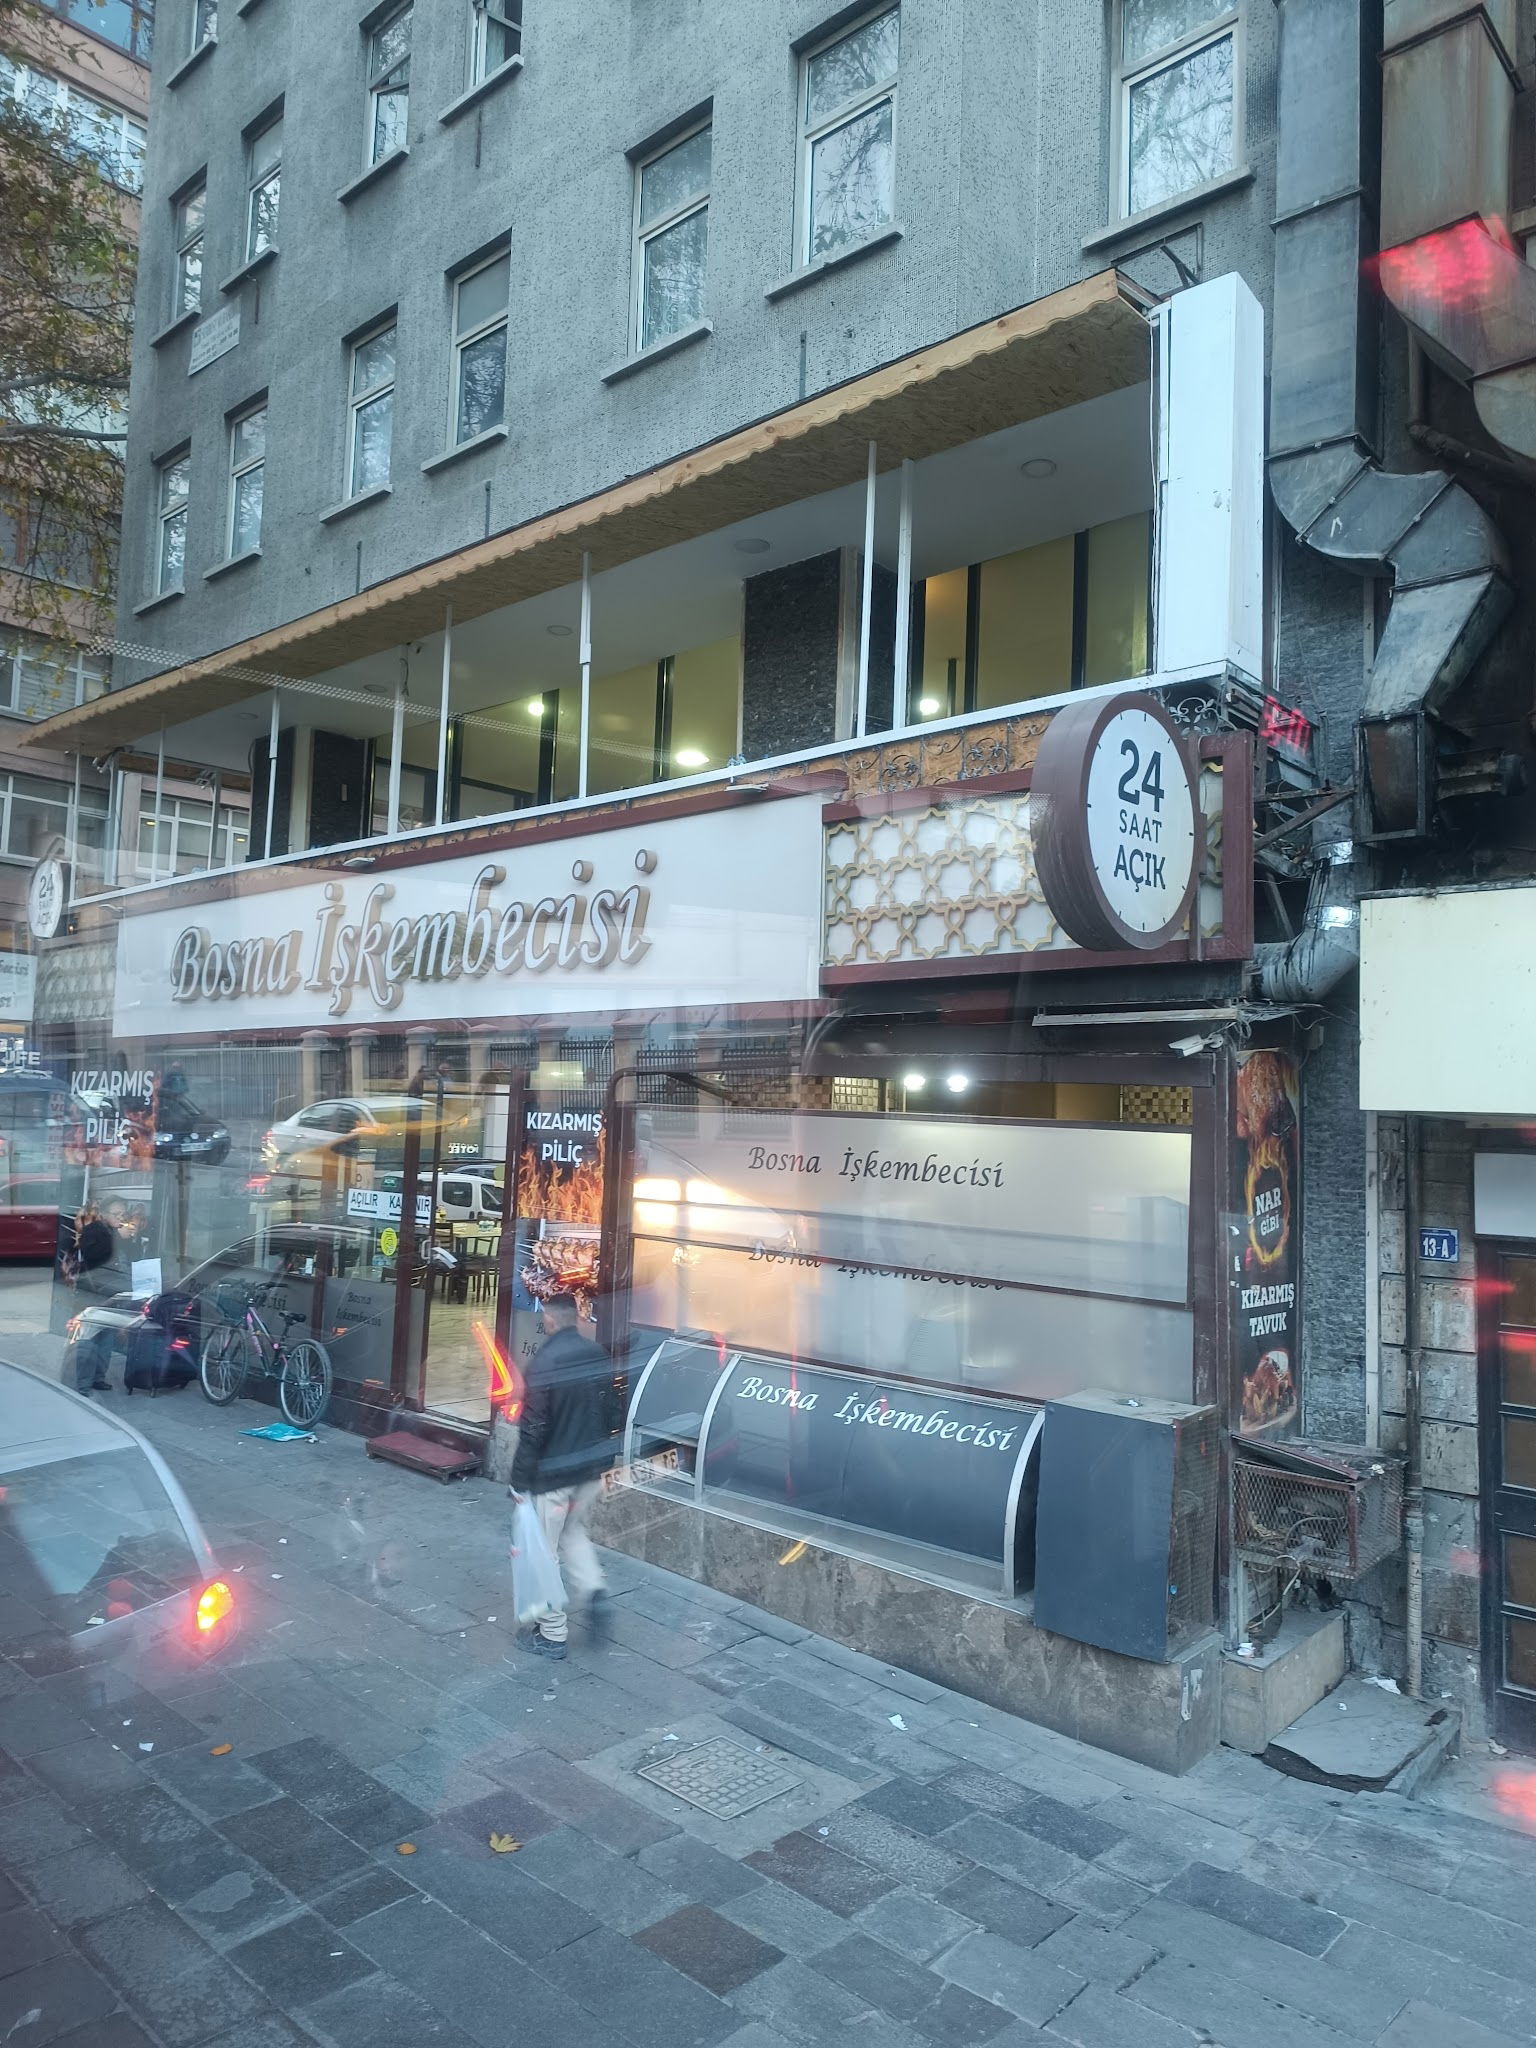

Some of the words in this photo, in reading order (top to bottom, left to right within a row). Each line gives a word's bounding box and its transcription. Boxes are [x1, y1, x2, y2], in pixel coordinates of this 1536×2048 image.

[1118, 739, 1165, 813] 24
[1119, 809, 1162, 843] SAAT
[1113, 844, 1166, 893] AÇIK
[170, 924, 304, 1003] Bosna
[304, 848, 659, 1016] İşkembecisi
[70, 1070, 154, 1105] KIZARMIŞ
[86, 1111, 130, 1154] PİLİÇ
[526, 1111, 602, 1137] KIZARMIŞ
[541, 1139, 583, 1168] PİLİÇ
[748, 1146, 822, 1174] Bosna
[838, 1147, 1005, 1188] İşkembecisi
[350, 1191, 379, 1208] AÇILIR
[1255, 1186, 1282, 1217] NAR
[1260, 1211, 1280, 1236] GİBİ
[1422, 1237, 1450, 1259] 13-A
[1241, 1282, 1295, 1309] KIZARMIŞ
[1249, 1312, 1287, 1337] TAVUK
[736, 1376, 820, 1411] Bosna
[833, 1391, 1019, 1451] İşkembecisi
